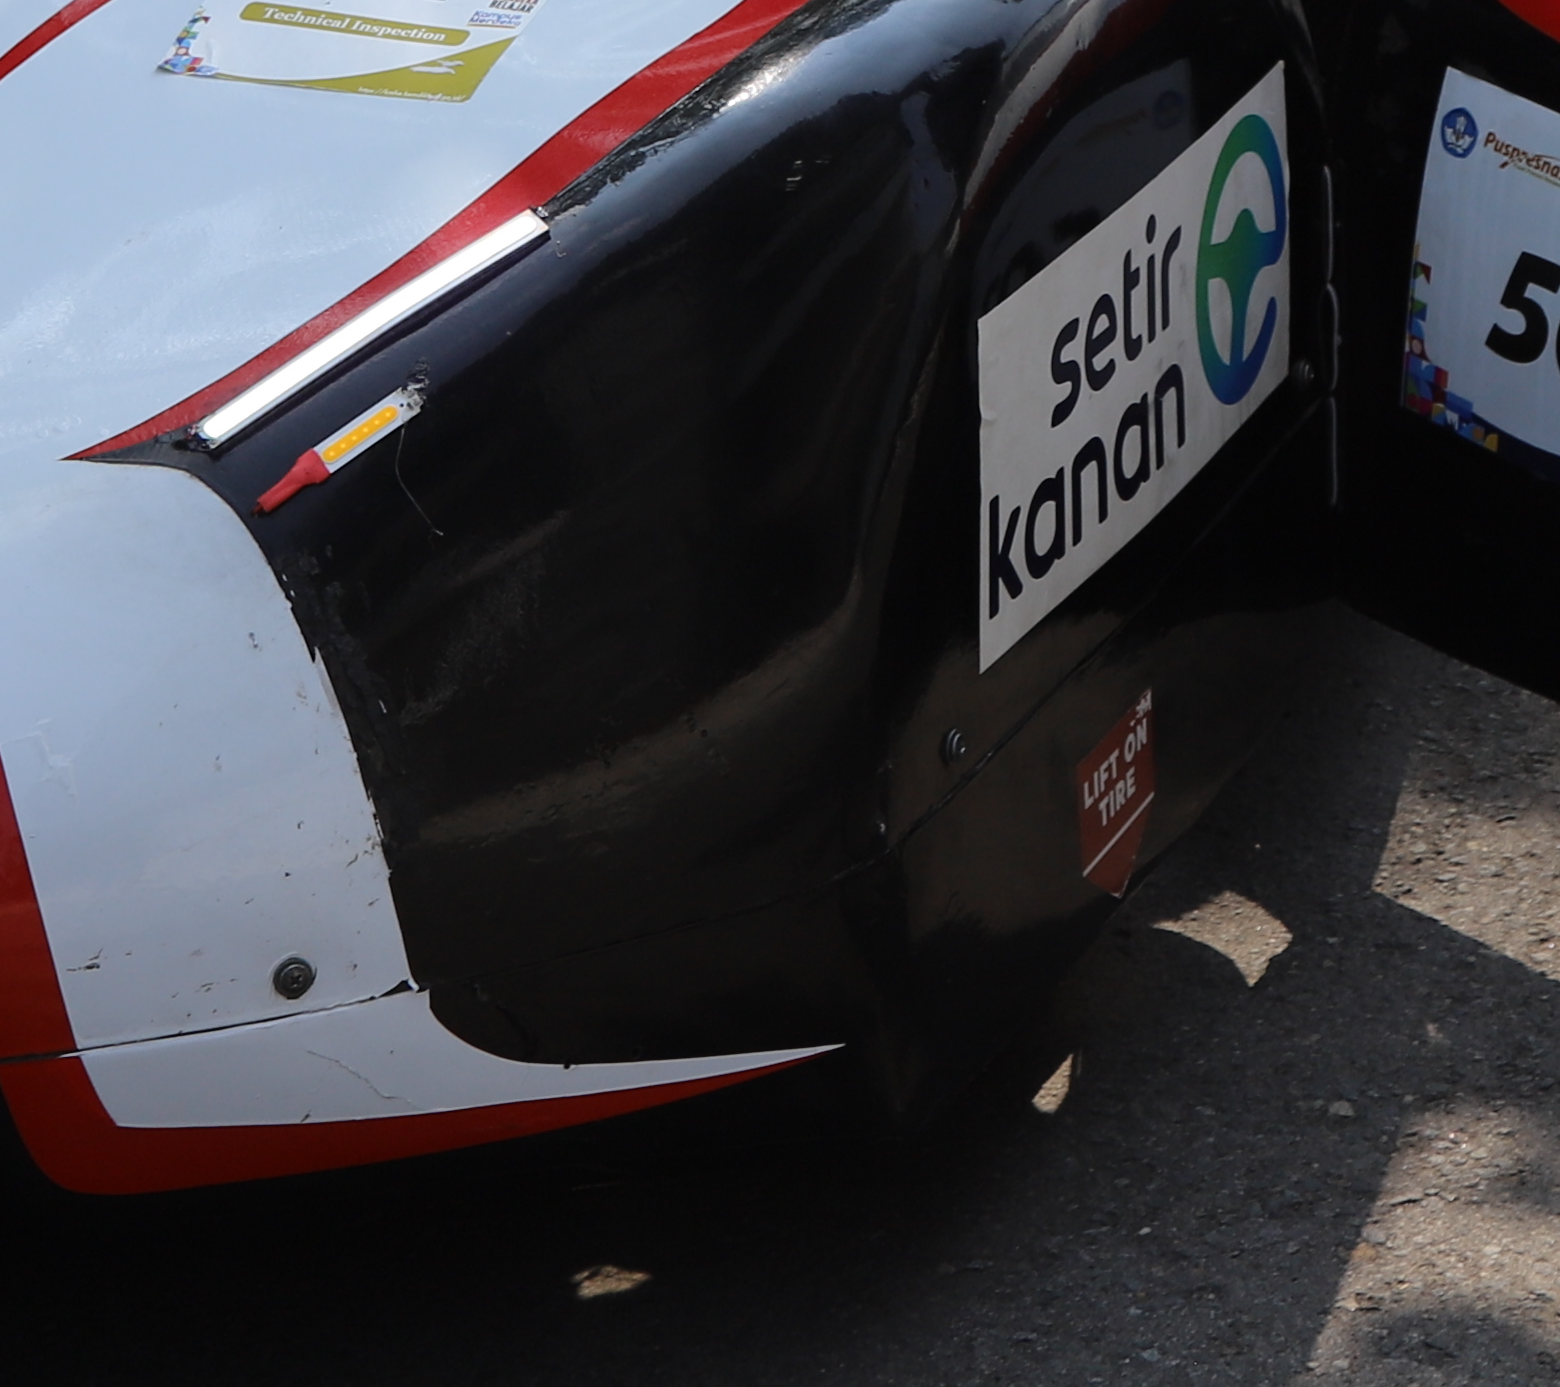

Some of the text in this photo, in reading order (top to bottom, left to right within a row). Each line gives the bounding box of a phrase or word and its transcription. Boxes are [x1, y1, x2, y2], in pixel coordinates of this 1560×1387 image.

[263, 6, 447, 43] Technical Inspection
[1050, 213, 1182, 429] setir
[988, 362, 1187, 620] kanan
[1083, 718, 1148, 809] LIFT ON
[1098, 766, 1137, 827] TIRE
